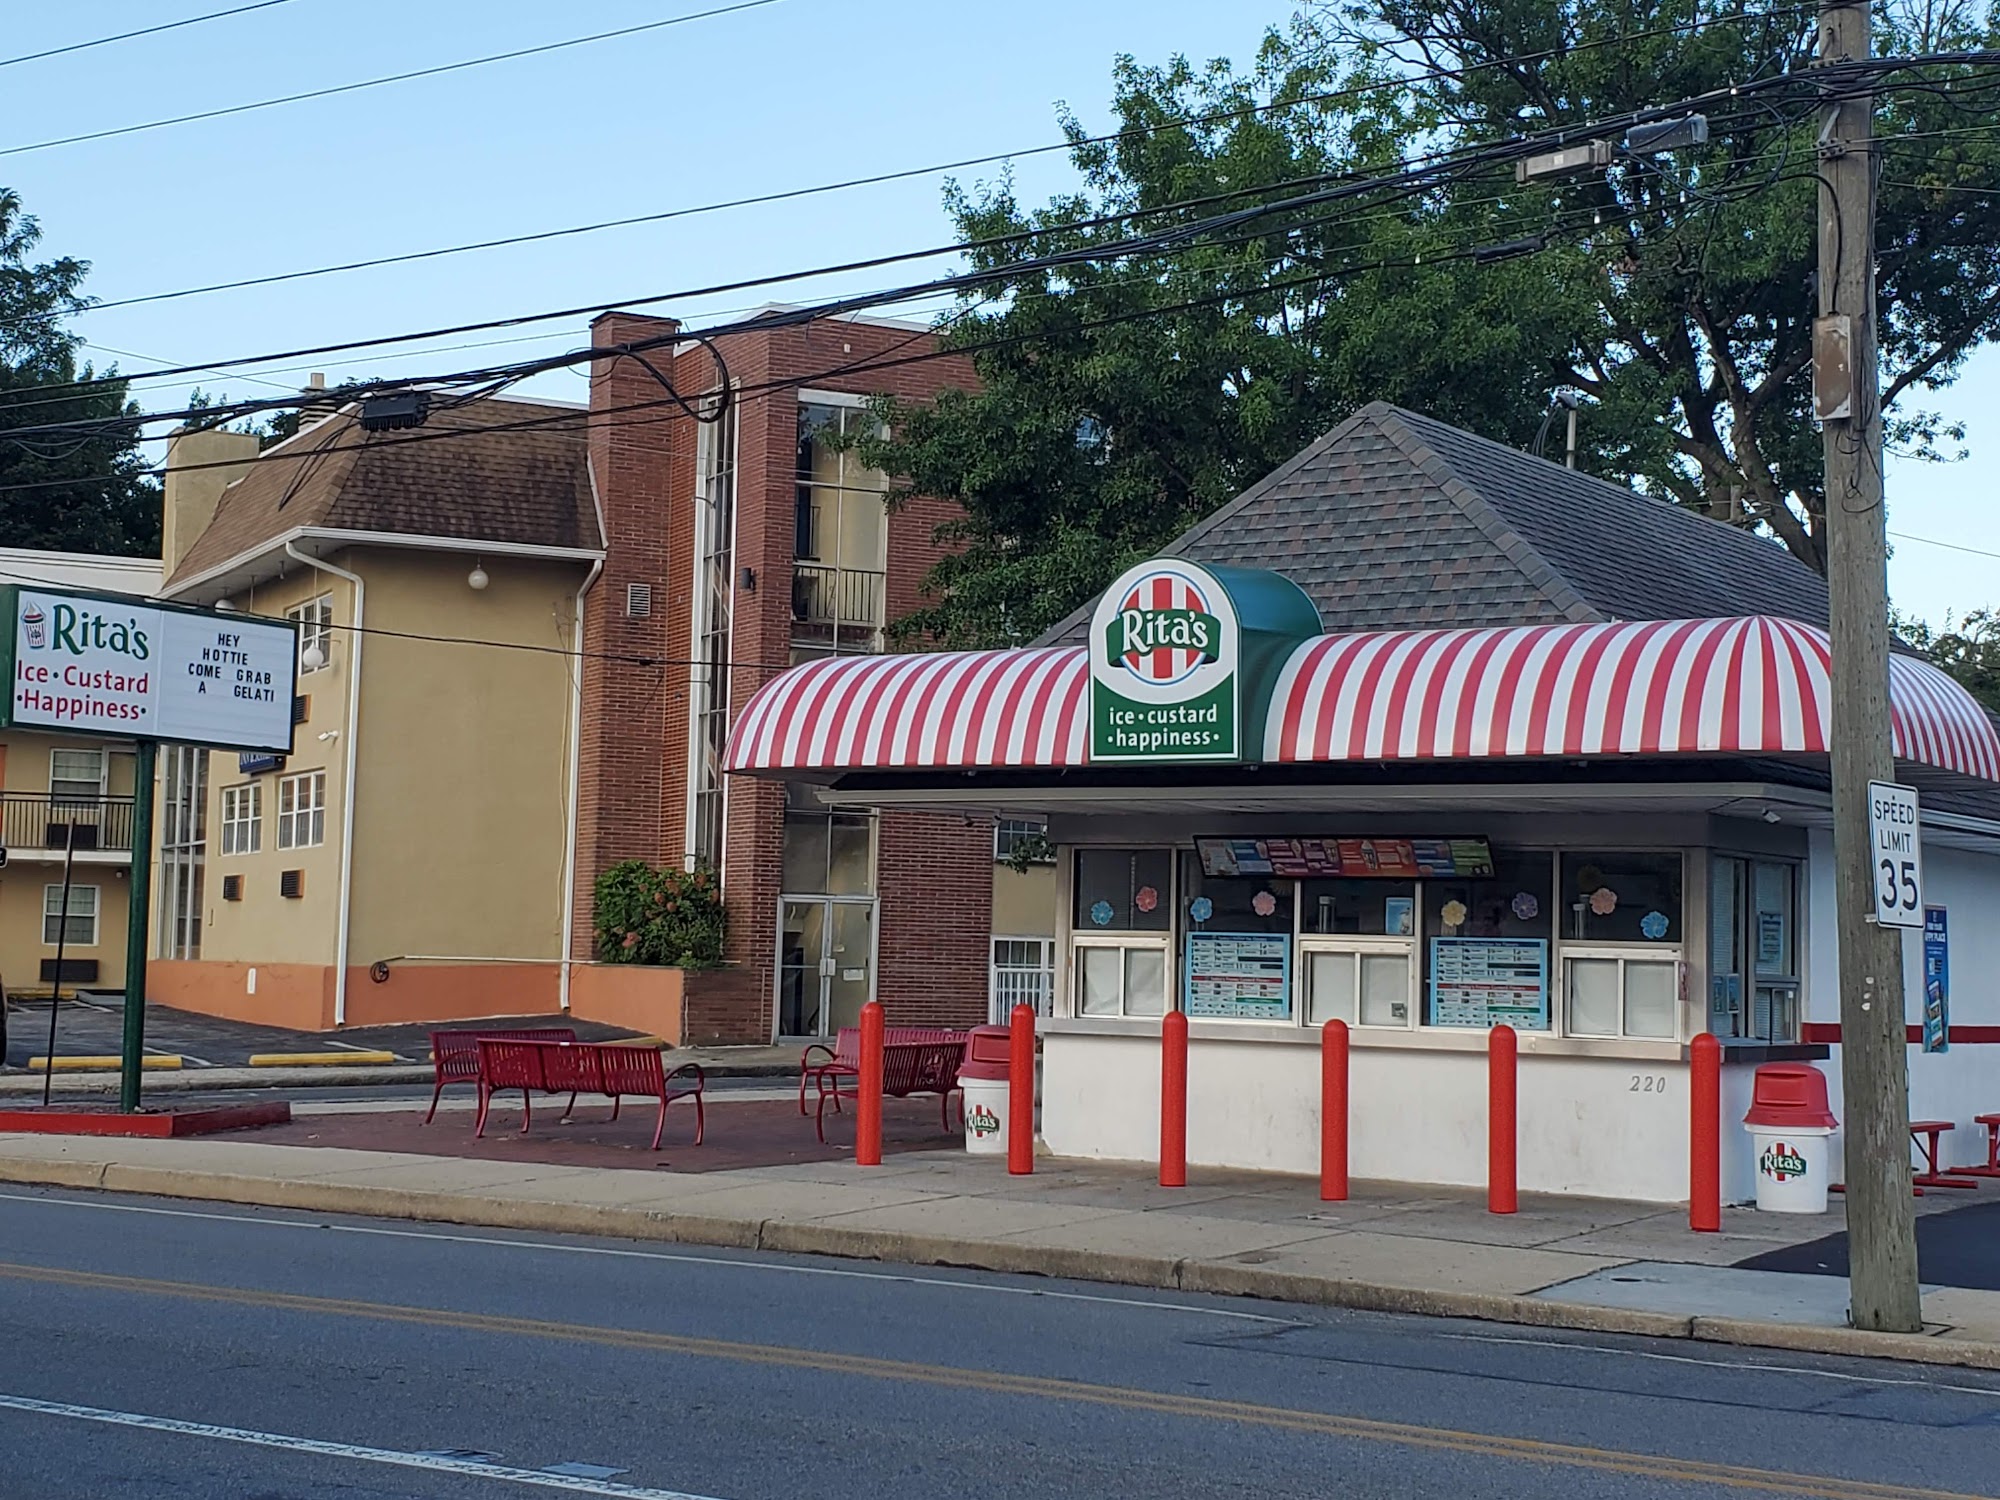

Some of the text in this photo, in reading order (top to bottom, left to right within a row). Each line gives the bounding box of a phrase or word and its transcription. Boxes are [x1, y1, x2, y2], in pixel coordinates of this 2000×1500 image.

[52, 603, 149, 660] Rita's
[218, 633, 241, 648] HEY
[1122, 609, 1209, 654] Rita's
[202, 649, 249, 666] HOTTIE
[17, 660, 148, 694] Ice Custard
[188, 663, 271, 685] COME GRAB
[198, 683, 275, 702] A GELATI
[1109, 703, 1217, 725] ice custard
[1874, 799, 1915, 825] SPEED
[1880, 829, 1911, 853] LIMIT
[1880, 858, 1918, 911] 35
[1628, 1075, 1666, 1094] 220
[968, 1113, 996, 1129] Rita's
[1764, 1152, 1802, 1171] Rita's
